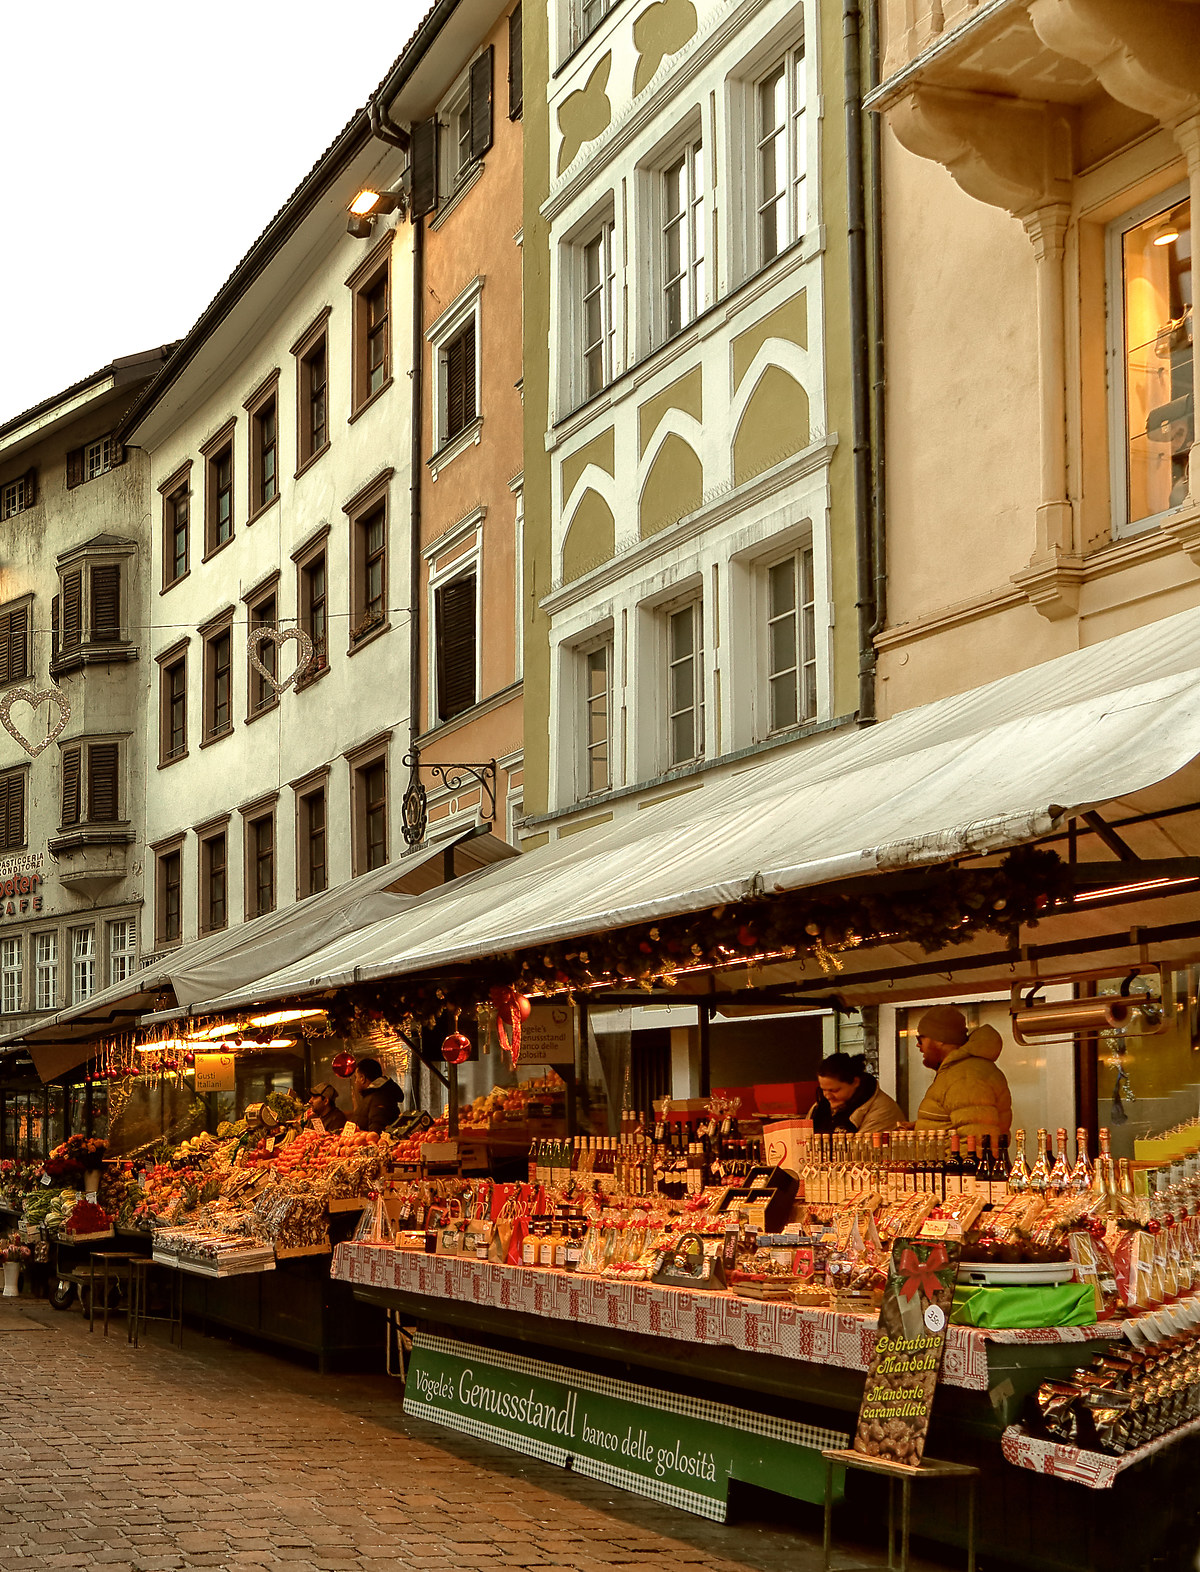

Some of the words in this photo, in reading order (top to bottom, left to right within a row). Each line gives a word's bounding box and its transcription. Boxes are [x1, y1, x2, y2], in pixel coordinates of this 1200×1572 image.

[521, 1033, 566, 1041] enussstandl
[197, 1072, 216, 1080] Gusti
[197, 1080, 222, 1088] Italiani
[875, 1335, 941, 1354] Gebratene
[876, 1355, 936, 1375] Mandeln
[866, 1385, 924, 1402] Mandorle
[862, 1402, 927, 1419] caramellate
[416, 1369, 455, 1402] Vögele's
[459, 1368, 578, 1438] Genussstandl
[582, 1413, 619, 1452] banco
[621, 1426, 654, 1463] delle
[655, 1440, 717, 1483] golosità
